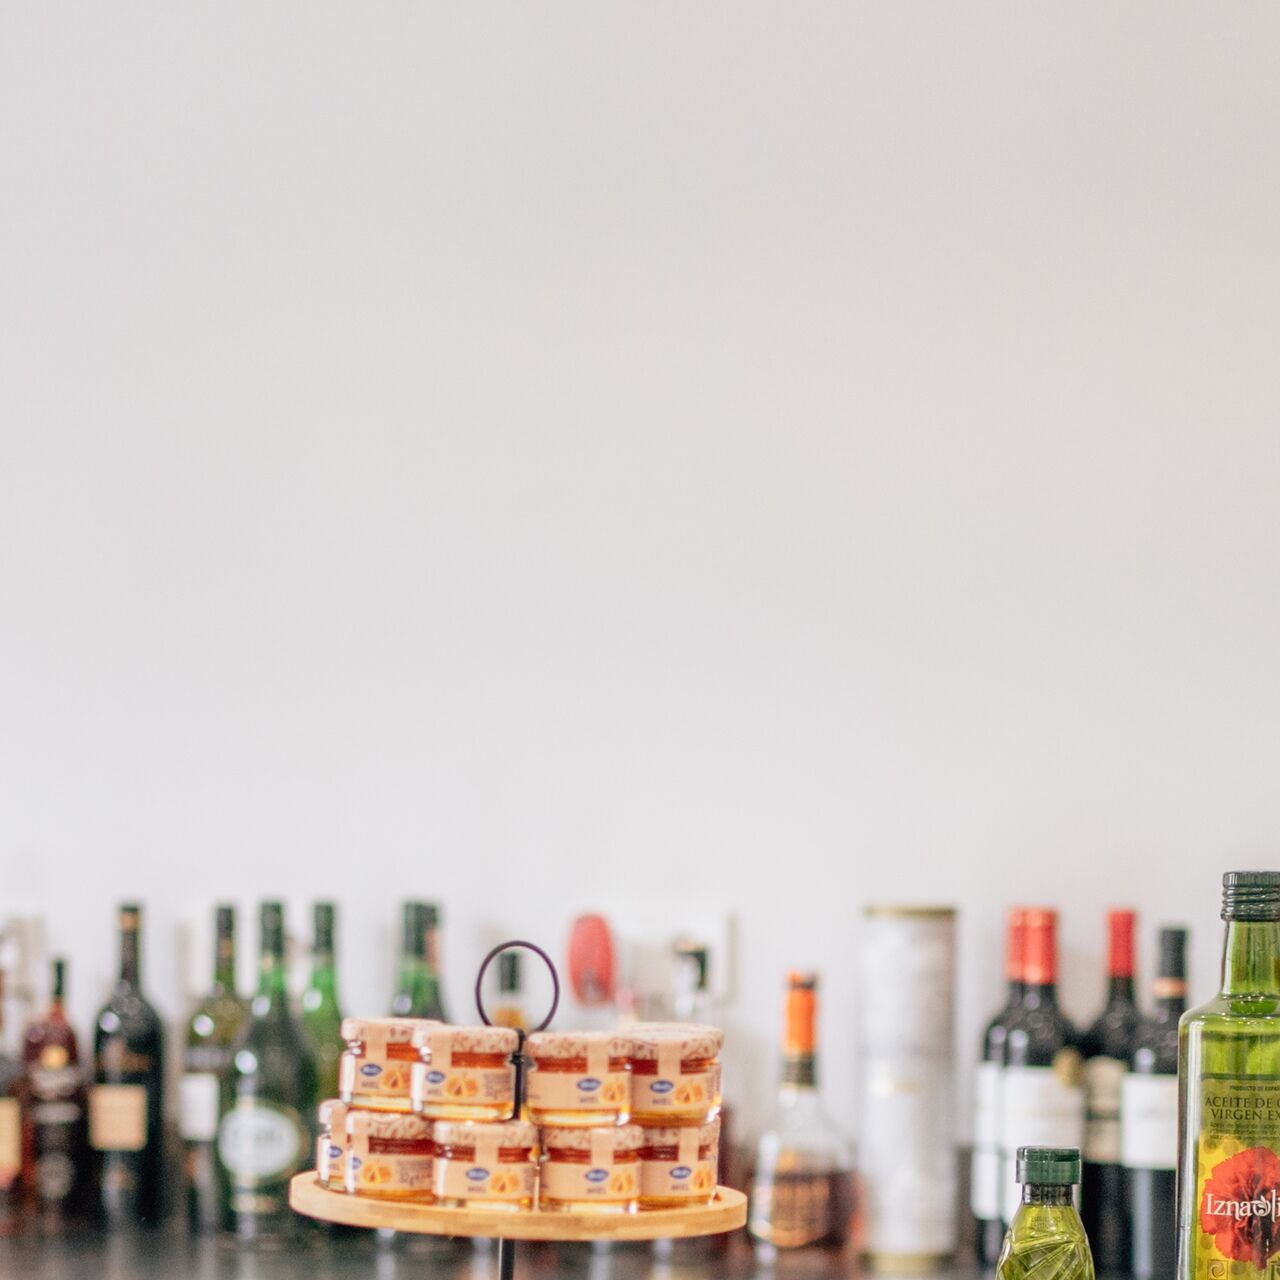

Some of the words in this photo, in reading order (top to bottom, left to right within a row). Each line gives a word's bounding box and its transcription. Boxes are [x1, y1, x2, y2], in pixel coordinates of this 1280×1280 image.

[1205, 1096, 1251, 1108] ACEITE
[1255, 1097, 1273, 1108] DE
[1211, 1108, 1262, 1120] VIRGEN
